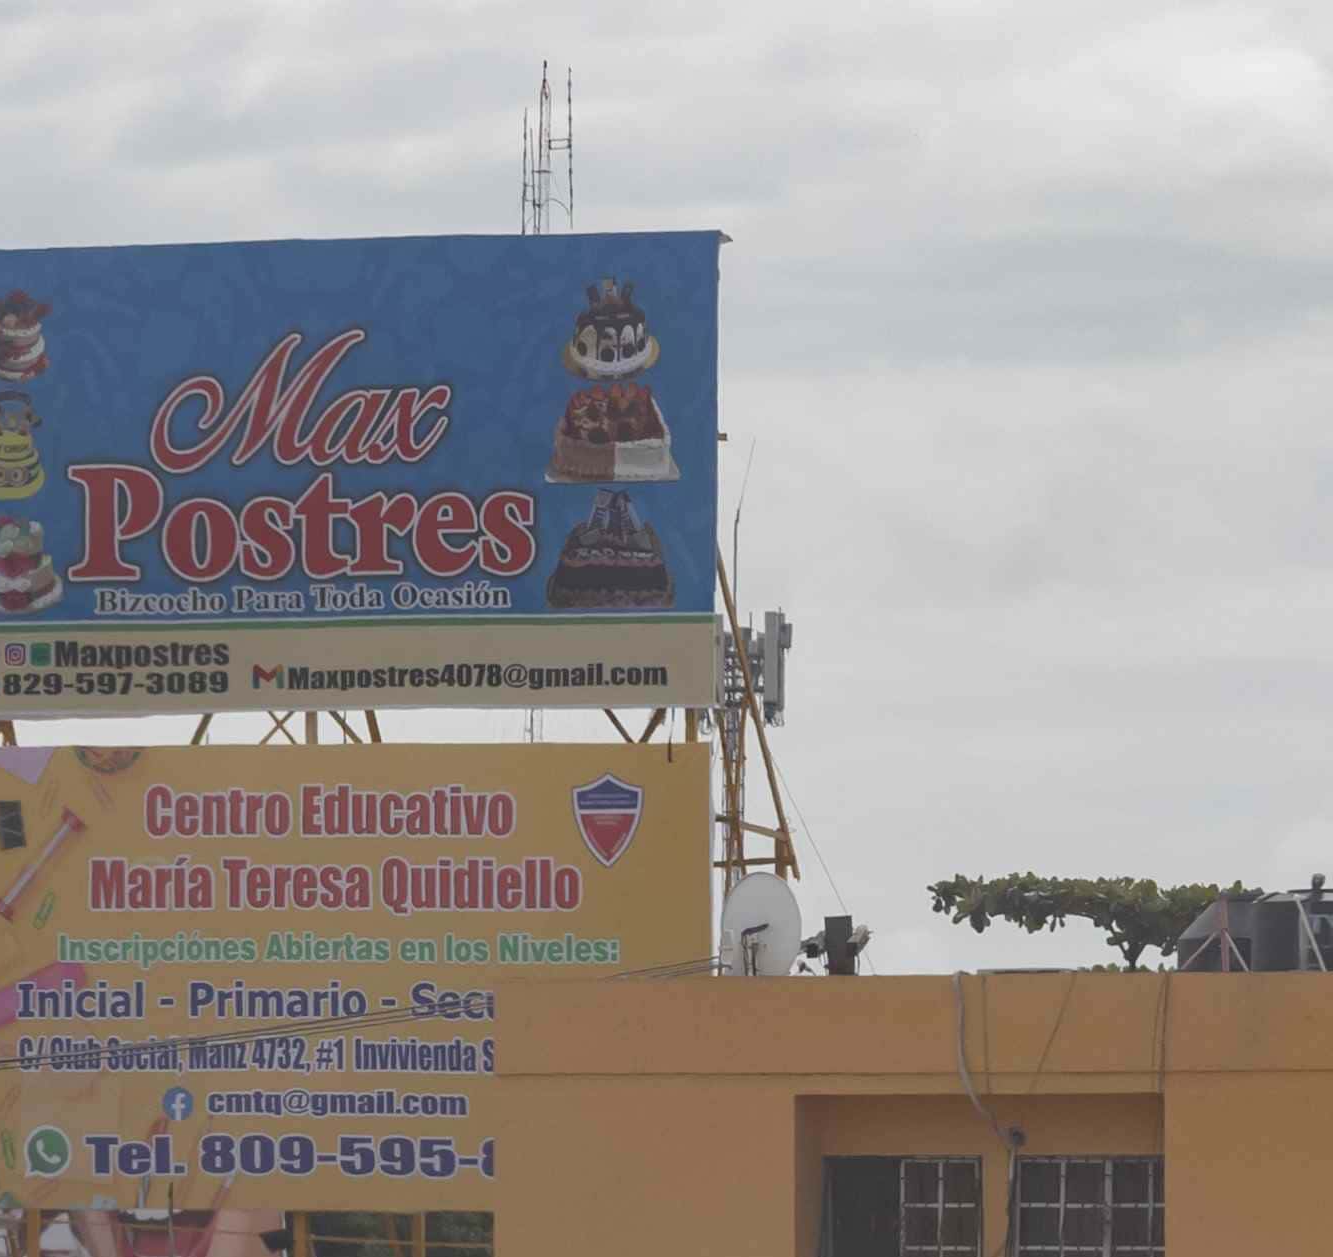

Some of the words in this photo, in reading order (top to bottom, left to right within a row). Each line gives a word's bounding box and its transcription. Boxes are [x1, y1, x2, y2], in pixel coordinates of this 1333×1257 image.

[150, 329, 451, 474] Max
[68, 464, 536, 583] Postres
[95, 586, 226, 615] Bizcocho
[233, 585, 304, 613] Para
[309, 583, 384, 611] Toda
[390, 580, 512, 611] Ocasión
[54, 641, 230, 669] Maxpostres
[2, 671, 230, 697] 829-597-3089
[288, 663, 668, 692] Maxpostres4078@gmail.com
[145, 783, 294, 840] Centro
[300, 784, 516, 839] Educativo
[89, 856, 215, 911] María
[223, 859, 372, 911] Teresa
[381, 856, 582, 915] Quidiello
[58, 931, 258, 969] Inscripciónes
[264, 931, 394, 964] Abiertas
[399, 938, 435, 963] en
[442, 932, 491, 963] los
[498, 932, 620, 965] Niveles:
[17, 980, 144, 1019] Inicial
[189, 980, 368, 1020] Primario
[50, 1037, 102, 1072] Club
[189, 1038, 247, 1071] Manz
[251, 1038, 312, 1074] 4732,
[316, 1037, 344, 1070] #1
[354, 1037, 477, 1072] Invivienda
[208, 1090, 469, 1116] cmtq@gmail.com
[84, 1134, 187, 1177] Tel.
